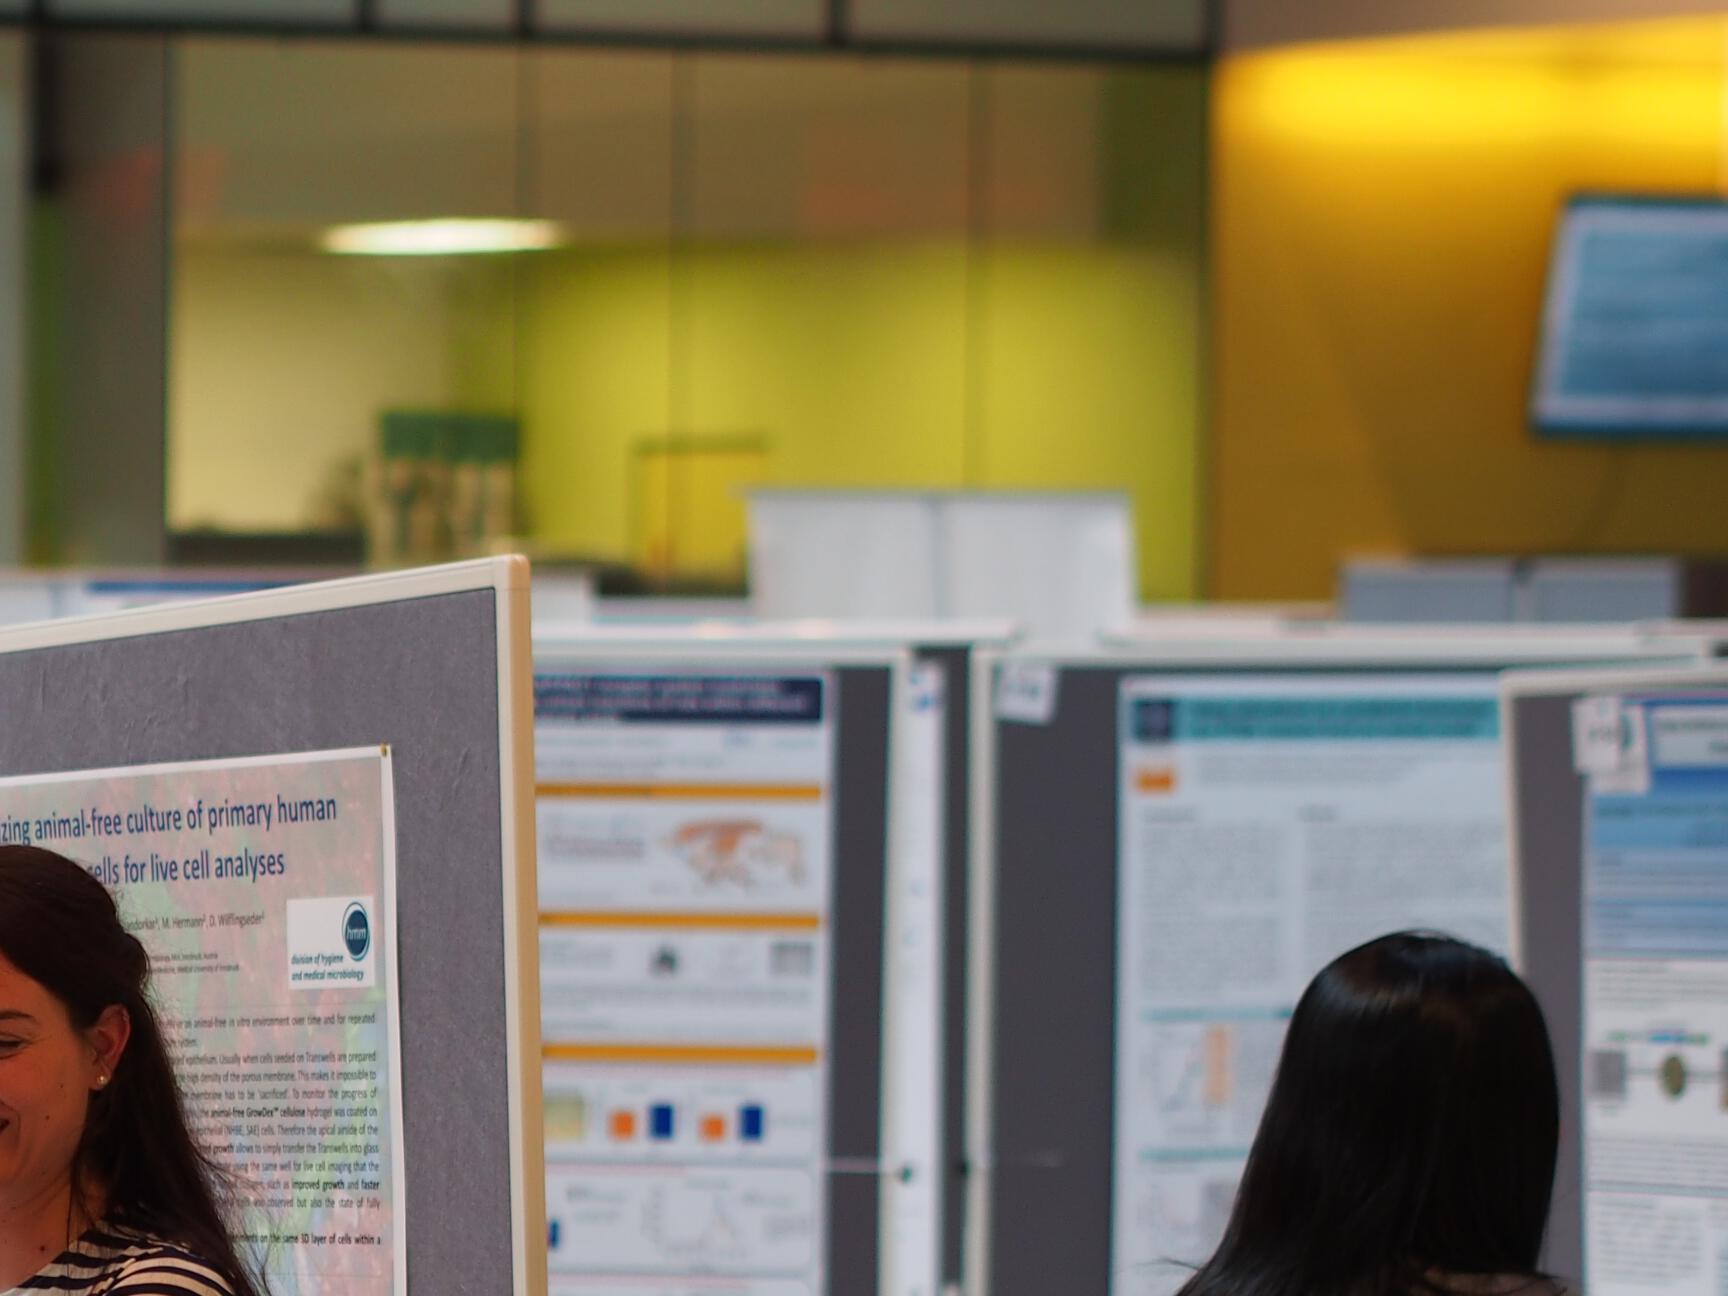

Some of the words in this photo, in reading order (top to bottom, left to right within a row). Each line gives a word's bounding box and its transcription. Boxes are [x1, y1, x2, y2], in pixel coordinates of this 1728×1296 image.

[34, 808, 123, 842] animal-free
[126, 804, 183, 837] culture
[187, 799, 204, 832] of
[208, 798, 273, 835] primary
[278, 794, 337, 824] human
[124, 854, 146, 884] for
[151, 853, 178, 882] live
[182, 849, 209, 881] cell
[214, 848, 285, 883] analyses
[292, 970, 302, 981] and
[303, 969, 325, 980] medical
[327, 969, 364, 982] microbiology
[348, 1050, 376, 1064] prepared
[336, 1069, 368, 1083] impossible
[340, 1090, 367, 1101] progress
[280, 1105, 305, 1117] cellulose
[213, 1142, 233, 1155] growth
[292, 1178, 319, 1191] improved
[321, 1178, 344, 1191] growth
[360, 1178, 380, 1189] faster
[311, 1232, 326, 1245] layer
[354, 1232, 374, 1244] within
